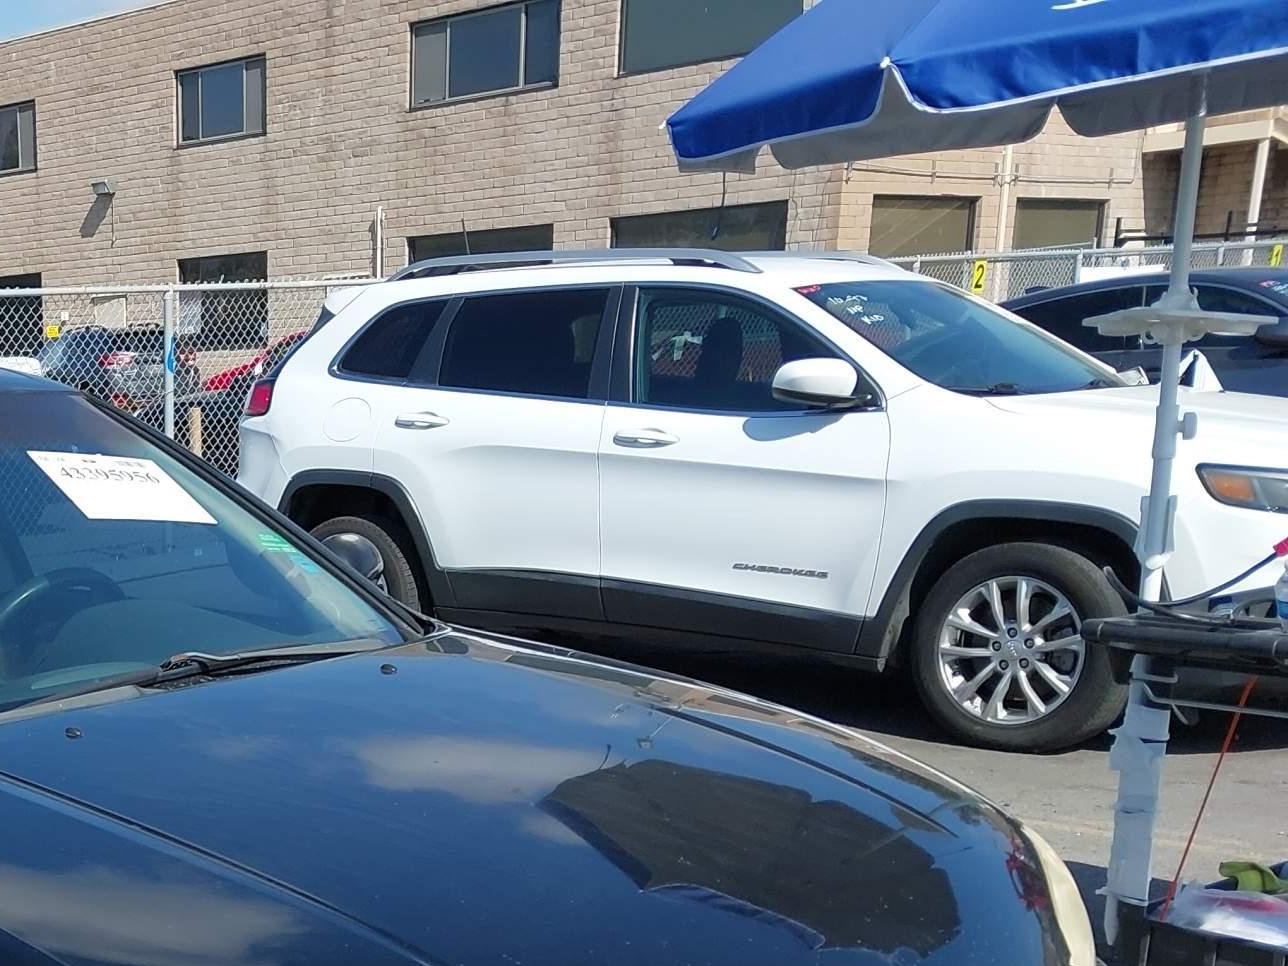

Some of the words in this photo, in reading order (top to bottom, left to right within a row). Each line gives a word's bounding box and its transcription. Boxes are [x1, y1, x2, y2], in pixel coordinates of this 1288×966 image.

[974, 264, 985, 289] 2
[60, 466, 160, 484] 43395956
[732, 563, 828, 579] CHEROKEE
